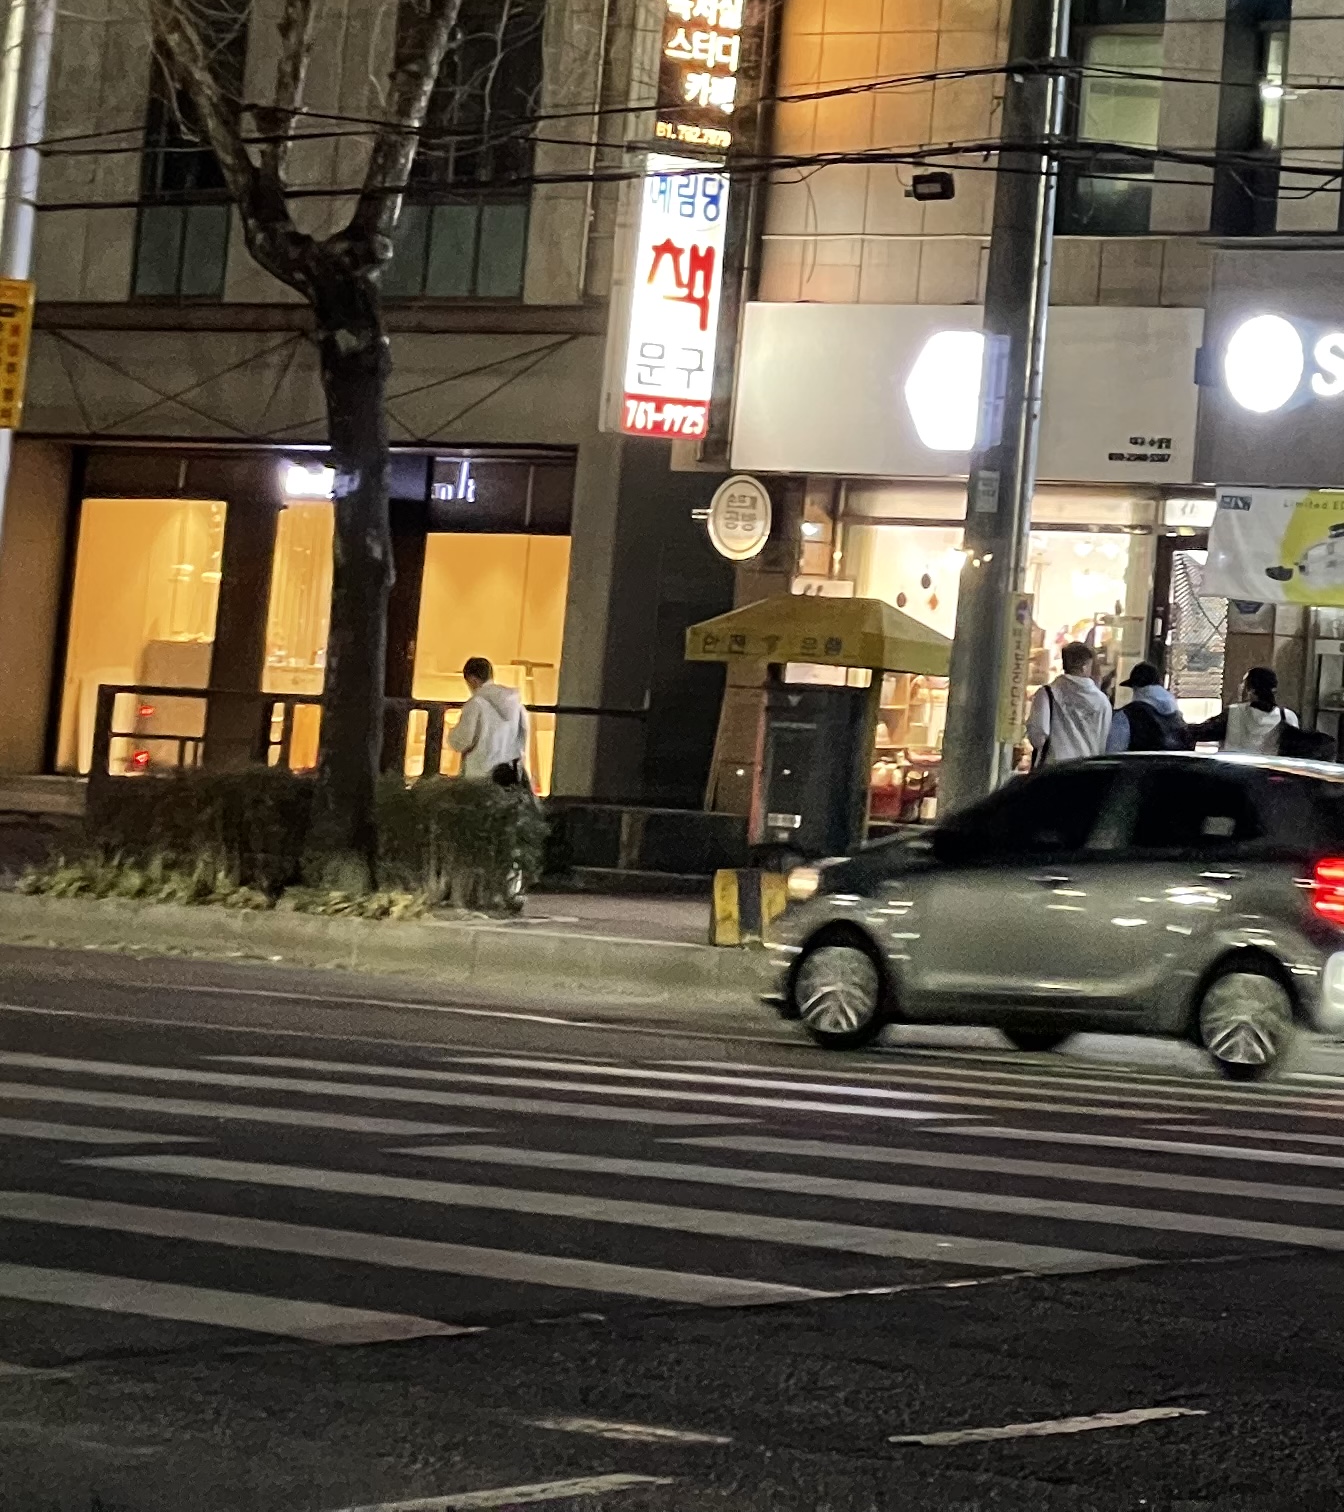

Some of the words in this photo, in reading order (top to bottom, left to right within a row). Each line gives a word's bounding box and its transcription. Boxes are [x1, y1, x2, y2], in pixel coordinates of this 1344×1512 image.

[666, 31, 740, 71] 스터디
[647, 238, 715, 331] 책
[636, 342, 704, 388] 문구
